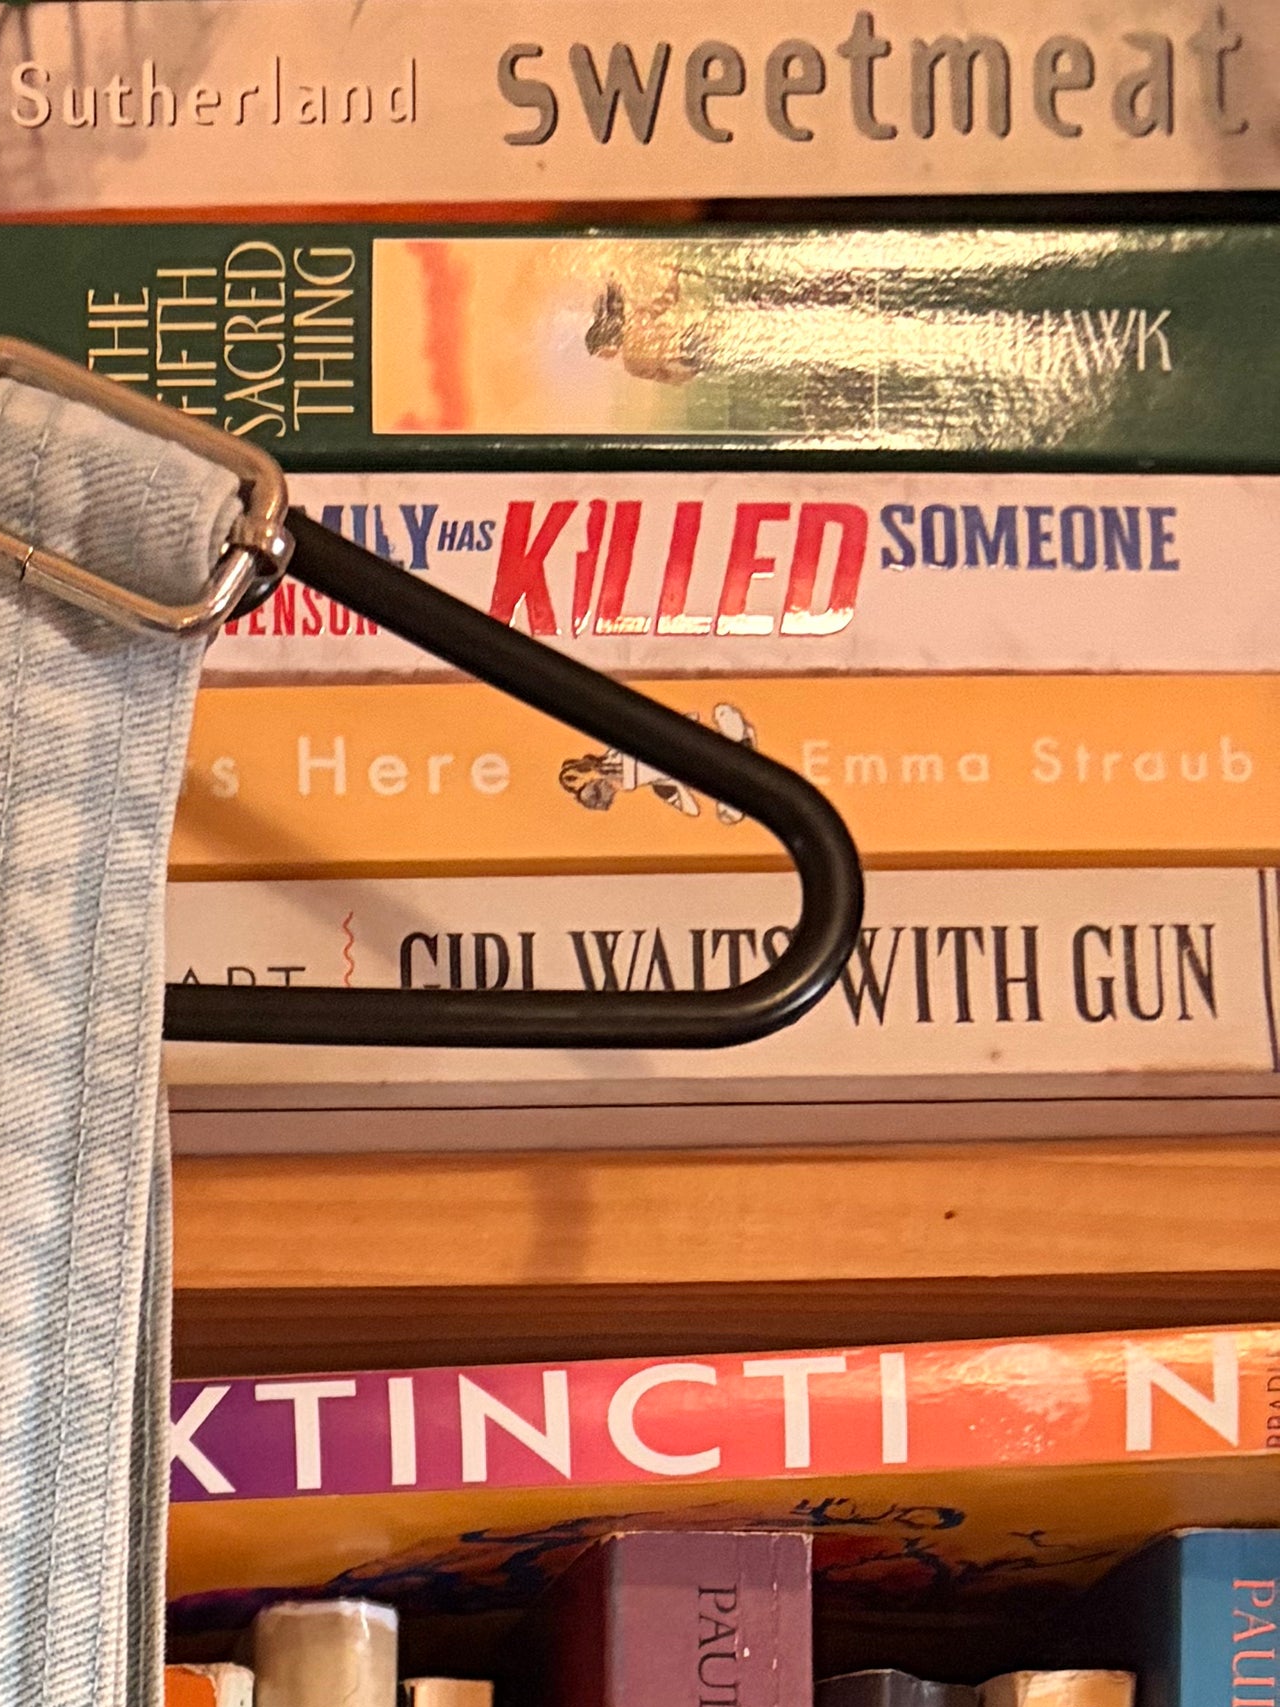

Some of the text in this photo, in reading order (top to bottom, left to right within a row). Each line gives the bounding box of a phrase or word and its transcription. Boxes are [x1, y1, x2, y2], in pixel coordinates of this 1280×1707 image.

[11, 55, 420, 131] Sutherland
[497, 6, 1248, 146] sweetmeat
[224, 241, 287, 438] SACRED
[292, 246, 357, 432] THING
[437, 499, 1181, 638] HAS KILLED SOMEONE
[296, 735, 513, 798] Here
[802, 736, 1256, 788] Emma Straub
[842, 924, 1221, 1025] WITH GUN
